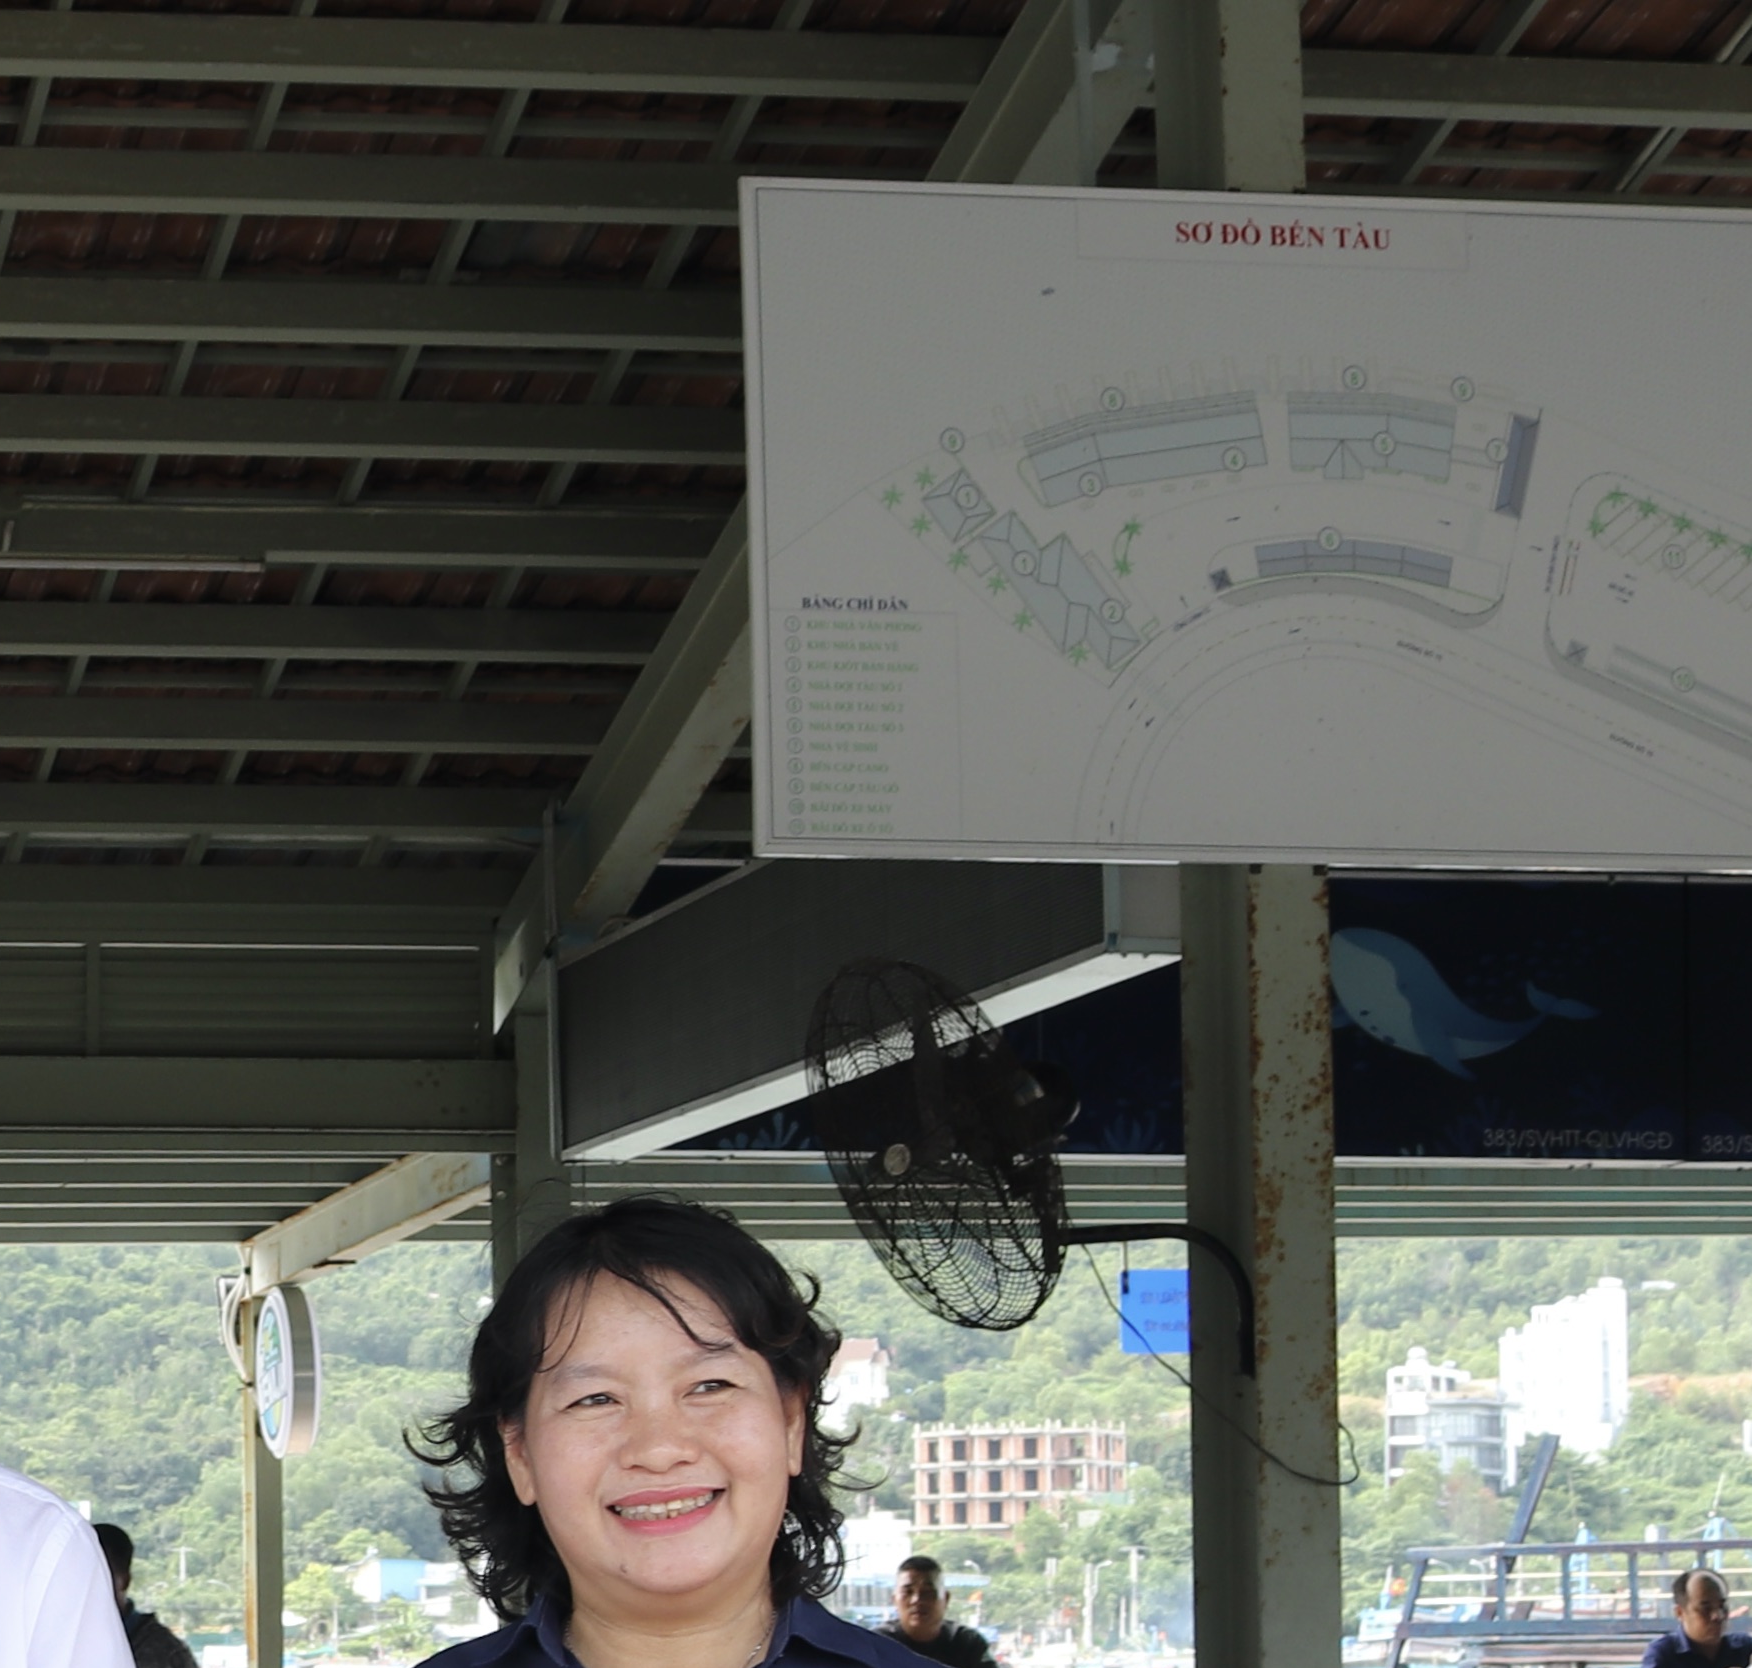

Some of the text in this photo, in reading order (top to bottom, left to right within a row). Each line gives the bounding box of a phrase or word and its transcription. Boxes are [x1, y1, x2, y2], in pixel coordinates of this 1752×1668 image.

[1175, 218, 1391, 249] SƠ ĐỒ BẾN TÀU
[802, 596, 908, 611] BẢNG CHỈ DẪN
